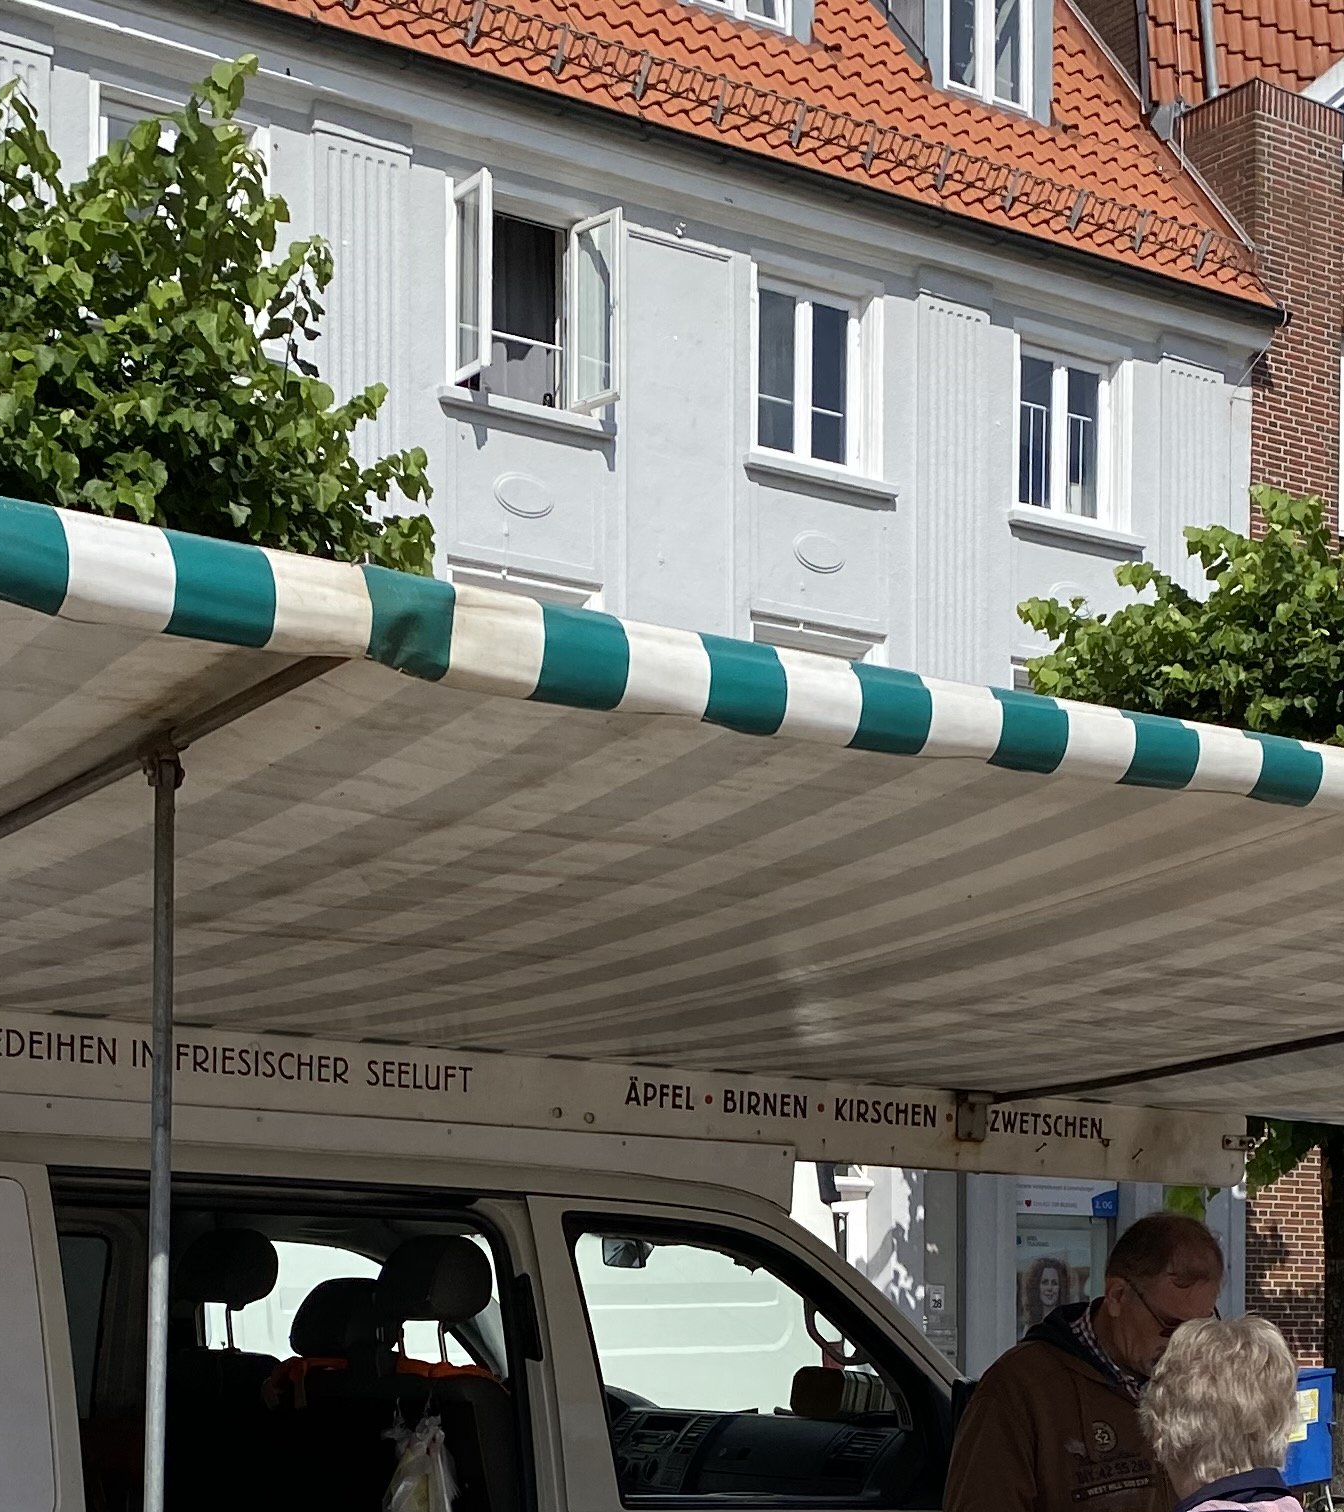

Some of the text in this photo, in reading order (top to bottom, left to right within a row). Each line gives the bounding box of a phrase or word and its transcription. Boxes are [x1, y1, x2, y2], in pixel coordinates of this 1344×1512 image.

[132, 1039, 154, 1068] IN
[176, 1043, 350, 1085] FRIESISCHER
[366, 1059, 473, 1094] SEELUFT
[624, 1076, 1104, 1141] ÄPFEL BIRNEN KIRSCHEN ZWETSCHEN
